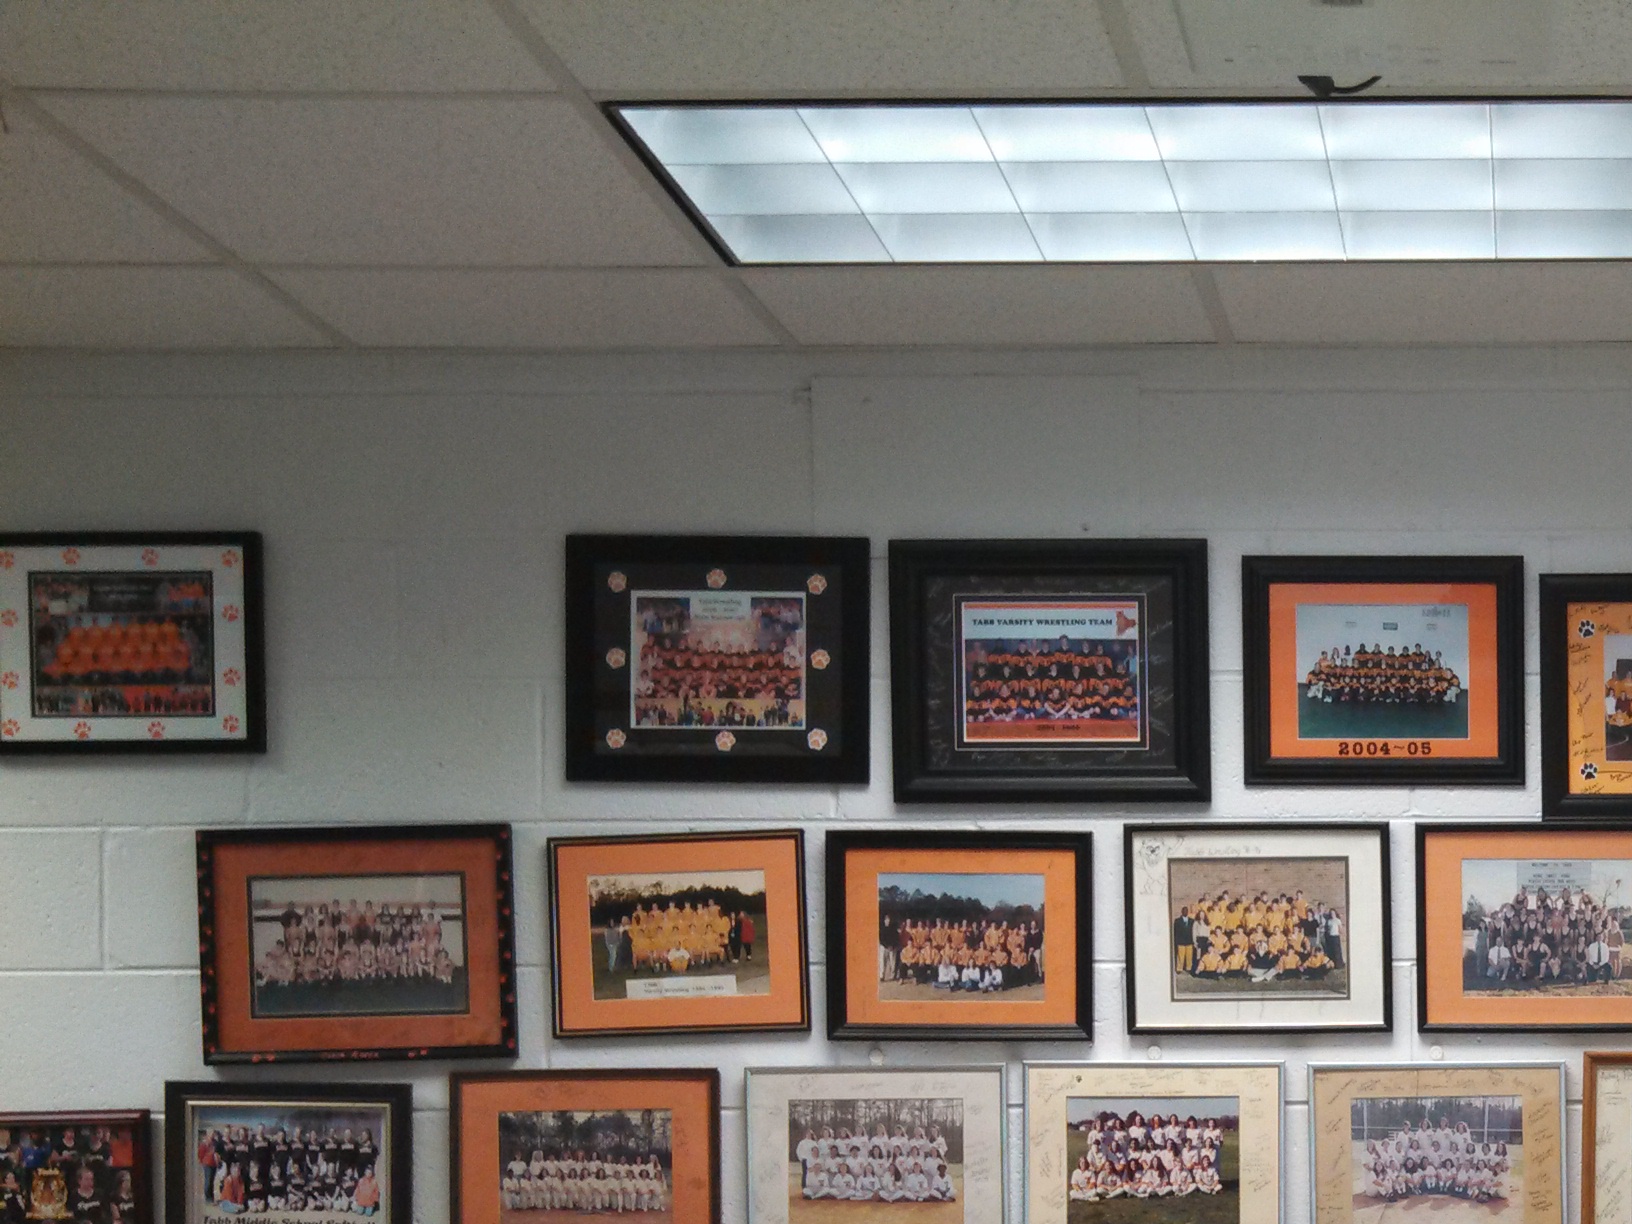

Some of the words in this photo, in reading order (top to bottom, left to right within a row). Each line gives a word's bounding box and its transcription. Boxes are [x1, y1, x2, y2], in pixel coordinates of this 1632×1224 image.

[972, 618, 995, 626] TABB
[997, 618, 1034, 626] VARSITY
[1036, 618, 1087, 626] WRESTLING
[1088, 618, 1113, 626] TEAM
